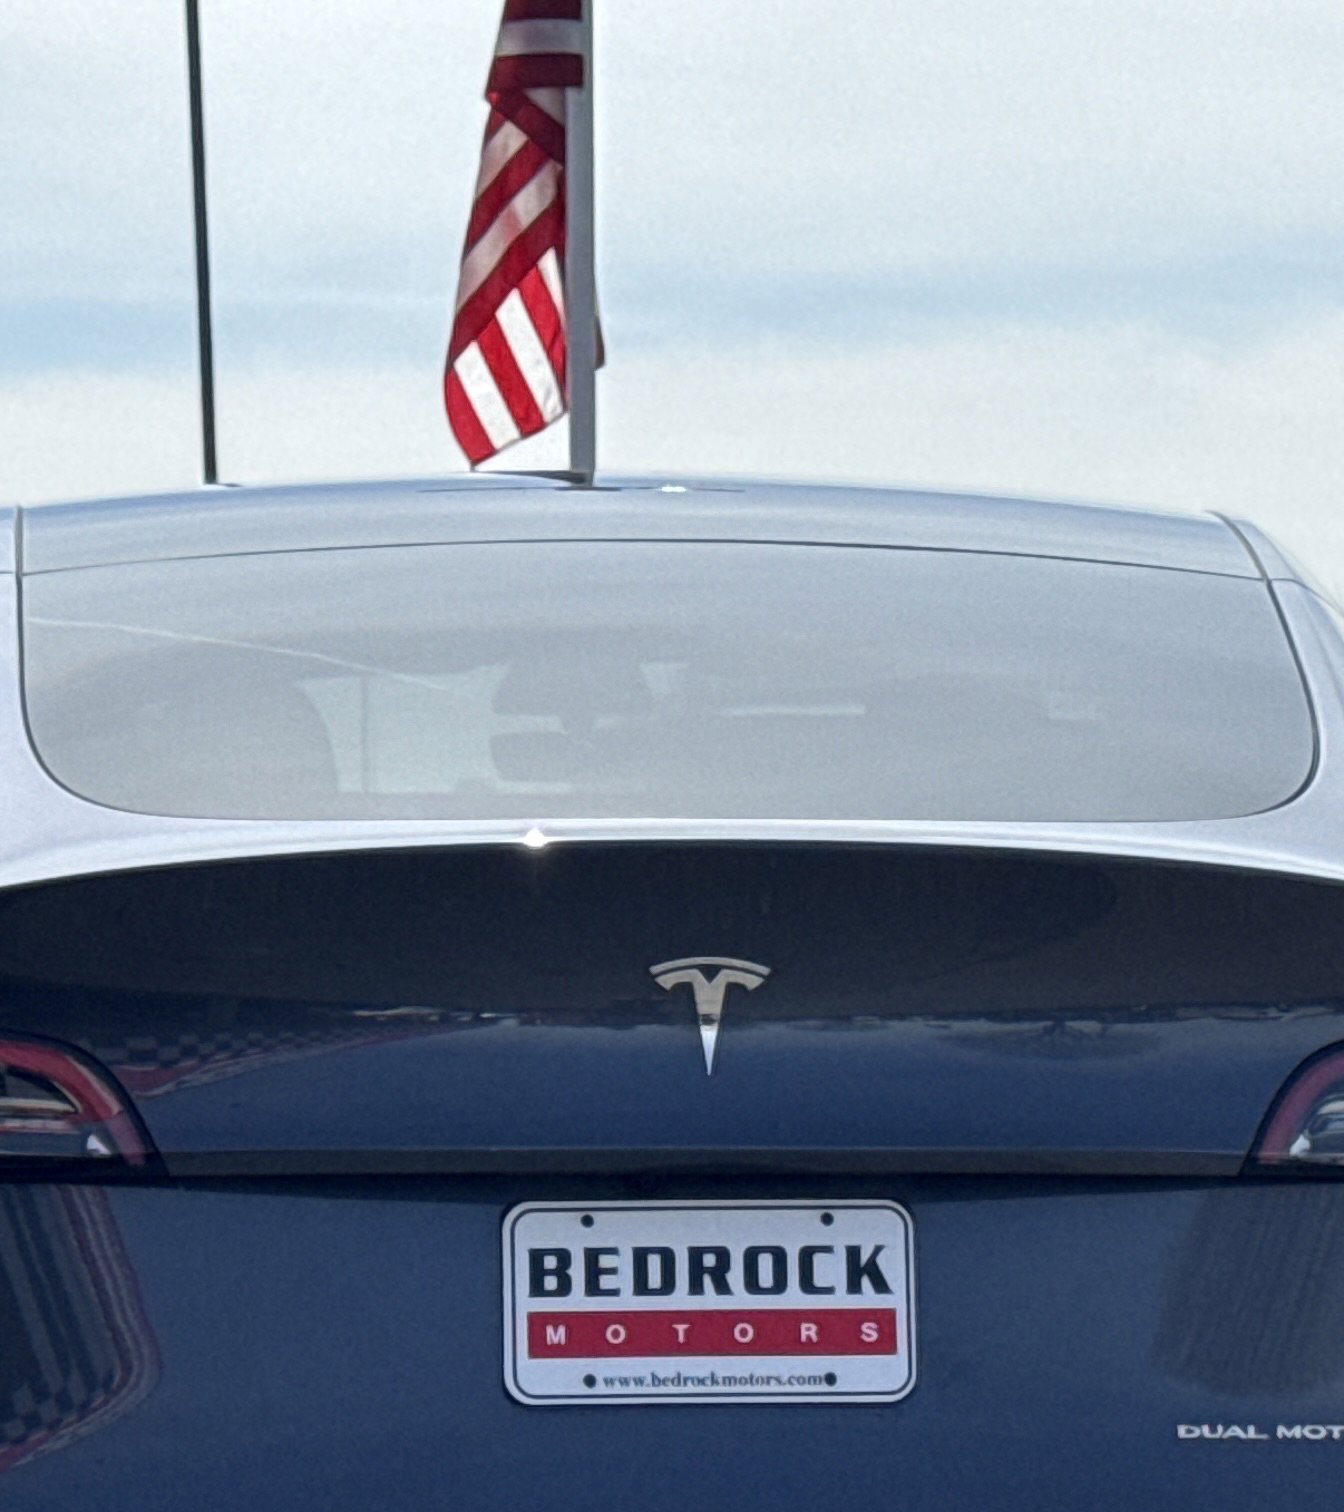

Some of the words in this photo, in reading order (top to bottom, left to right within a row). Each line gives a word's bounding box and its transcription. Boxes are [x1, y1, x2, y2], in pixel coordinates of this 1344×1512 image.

[527, 1244, 894, 1298] BEDROCK
[545, 1321, 880, 1346] MOTORS
[602, 1370, 825, 1389] www.bedrockmotors.com
[1176, 1424, 1270, 1440] DUAL
